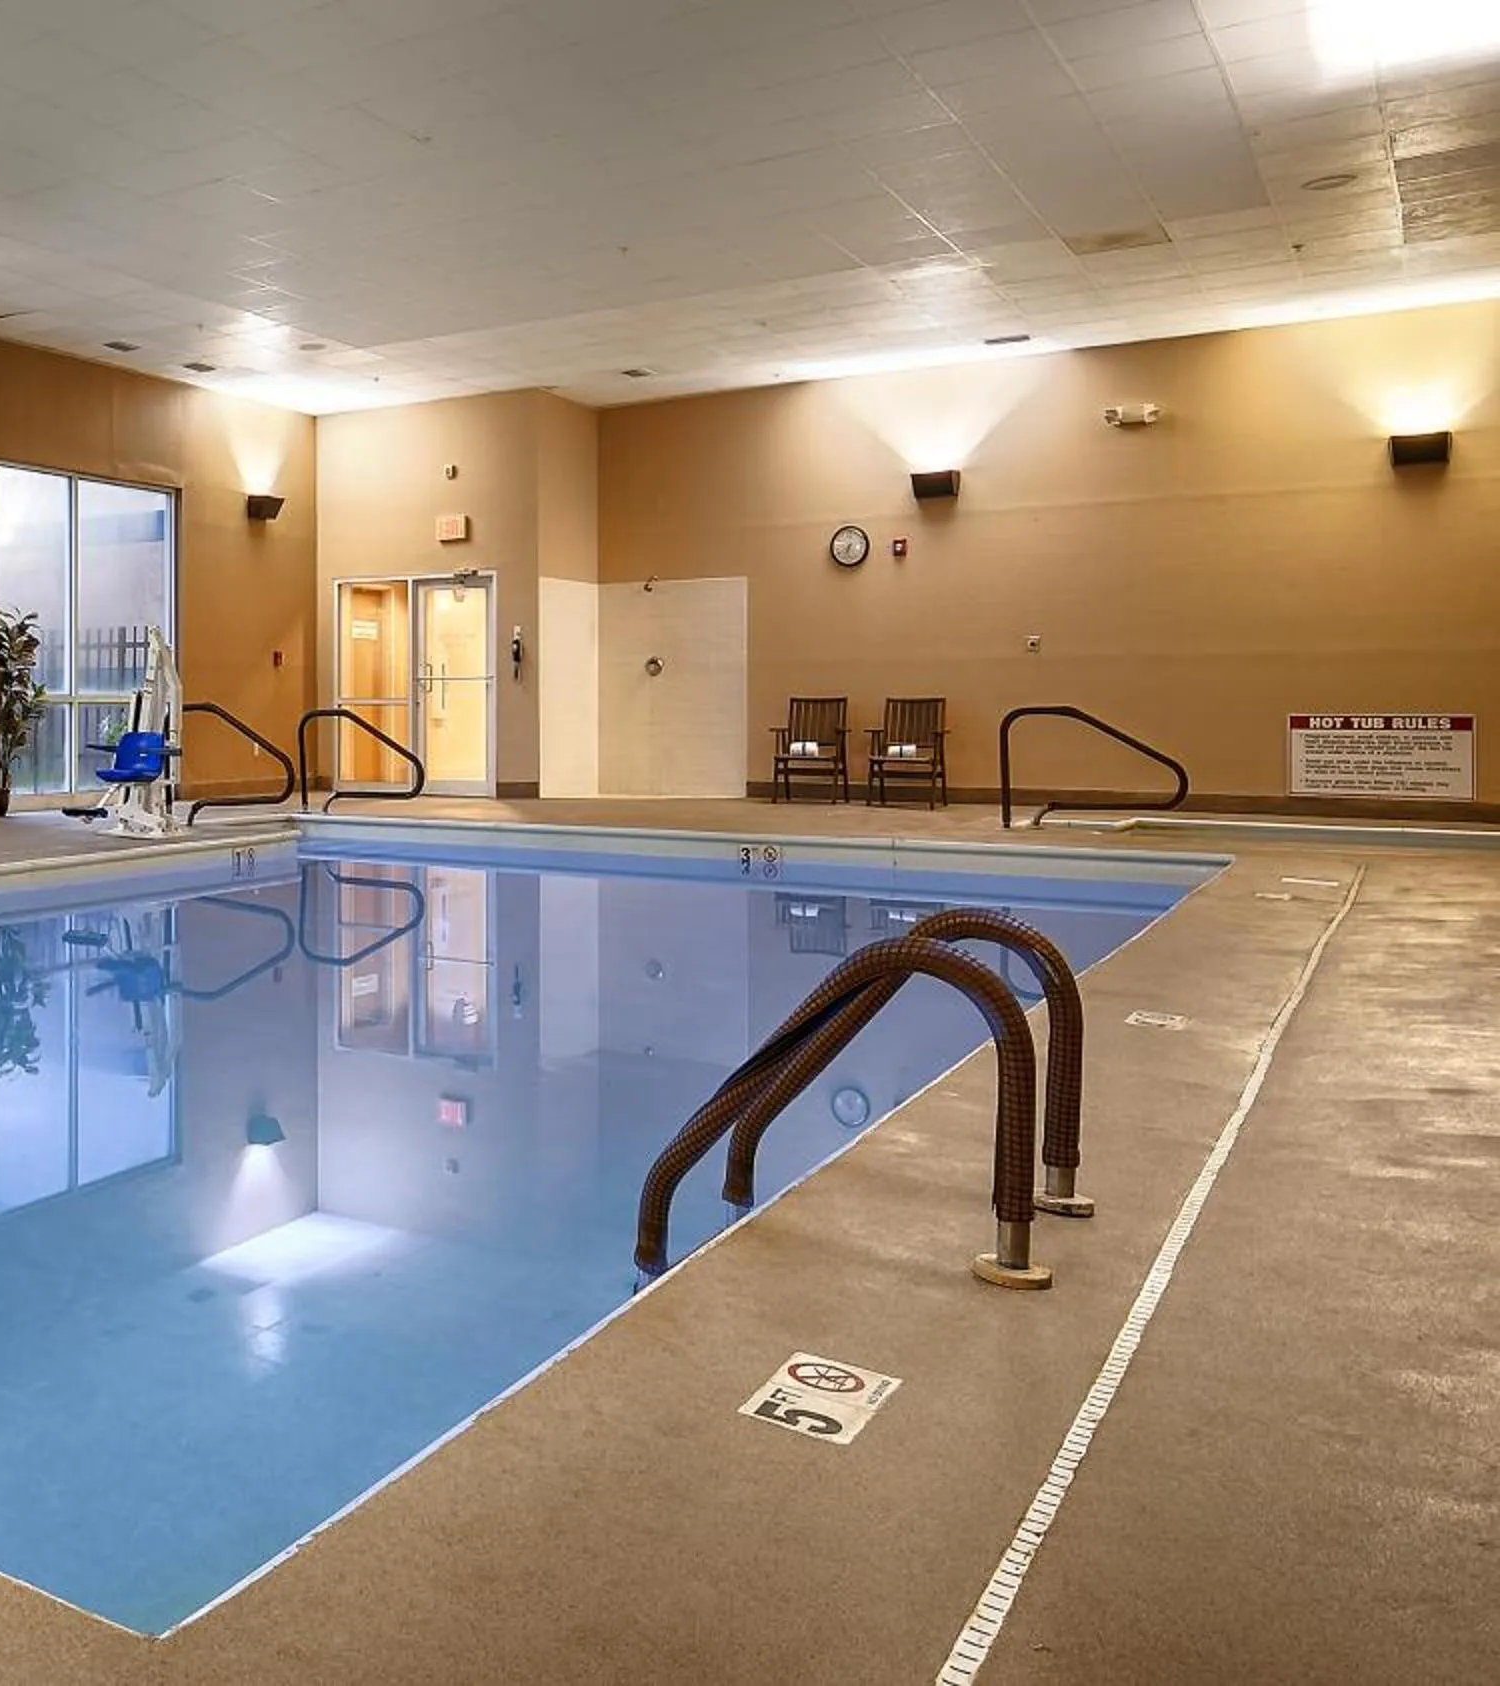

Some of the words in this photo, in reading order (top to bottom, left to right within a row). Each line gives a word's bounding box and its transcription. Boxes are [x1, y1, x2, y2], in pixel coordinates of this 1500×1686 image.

[1309, 717, 1344, 729] HOT
[1351, 717, 1385, 729] TUB
[1392, 717, 1452, 729] RULES
[770, 1387, 803, 1405] FT
[754, 1400, 843, 1434] 5
